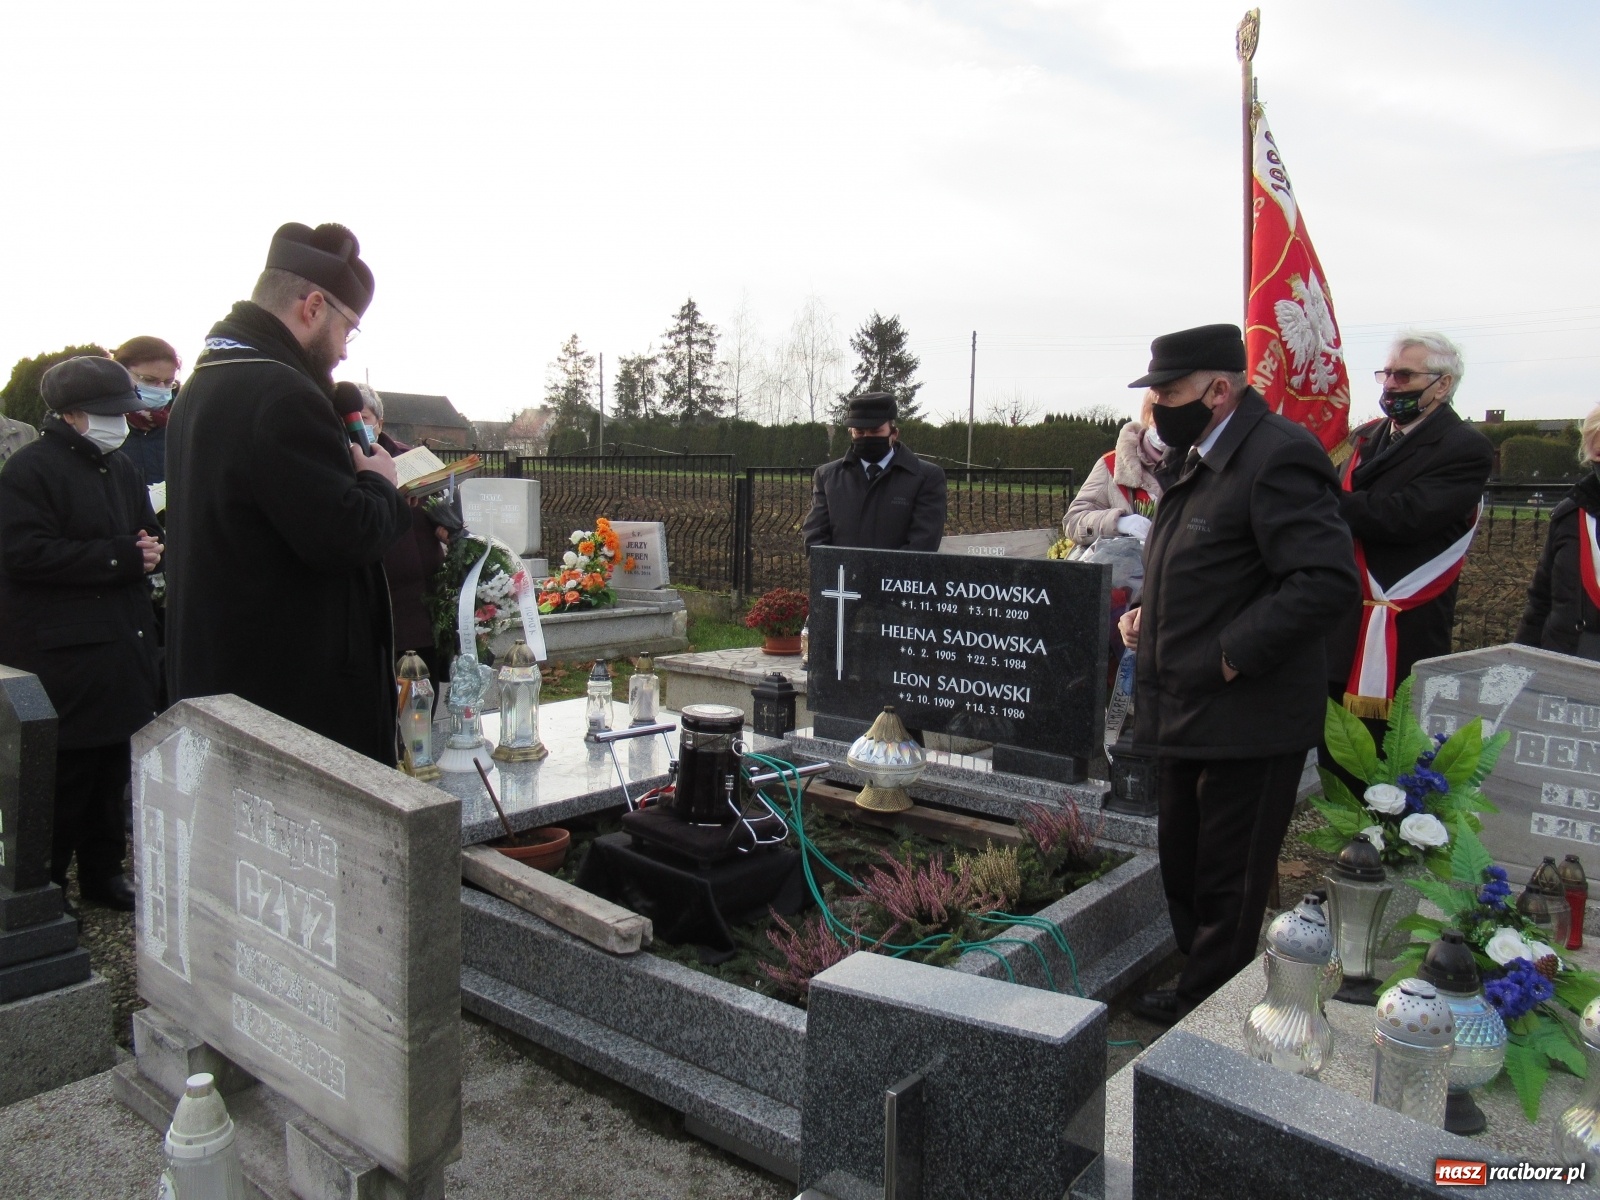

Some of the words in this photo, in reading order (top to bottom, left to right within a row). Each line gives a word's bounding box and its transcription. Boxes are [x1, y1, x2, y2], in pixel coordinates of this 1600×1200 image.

[626, 541, 648, 550] JERZY
[881, 578, 938, 596] IZABELA
[945, 581, 1051, 605] SADOWSKA
[881, 623, 937, 643] HELENA
[943, 628, 1048, 656] SADOWSKA
[893, 671, 931, 689] LEON
[937, 675, 1031, 703] SADOWSKI
